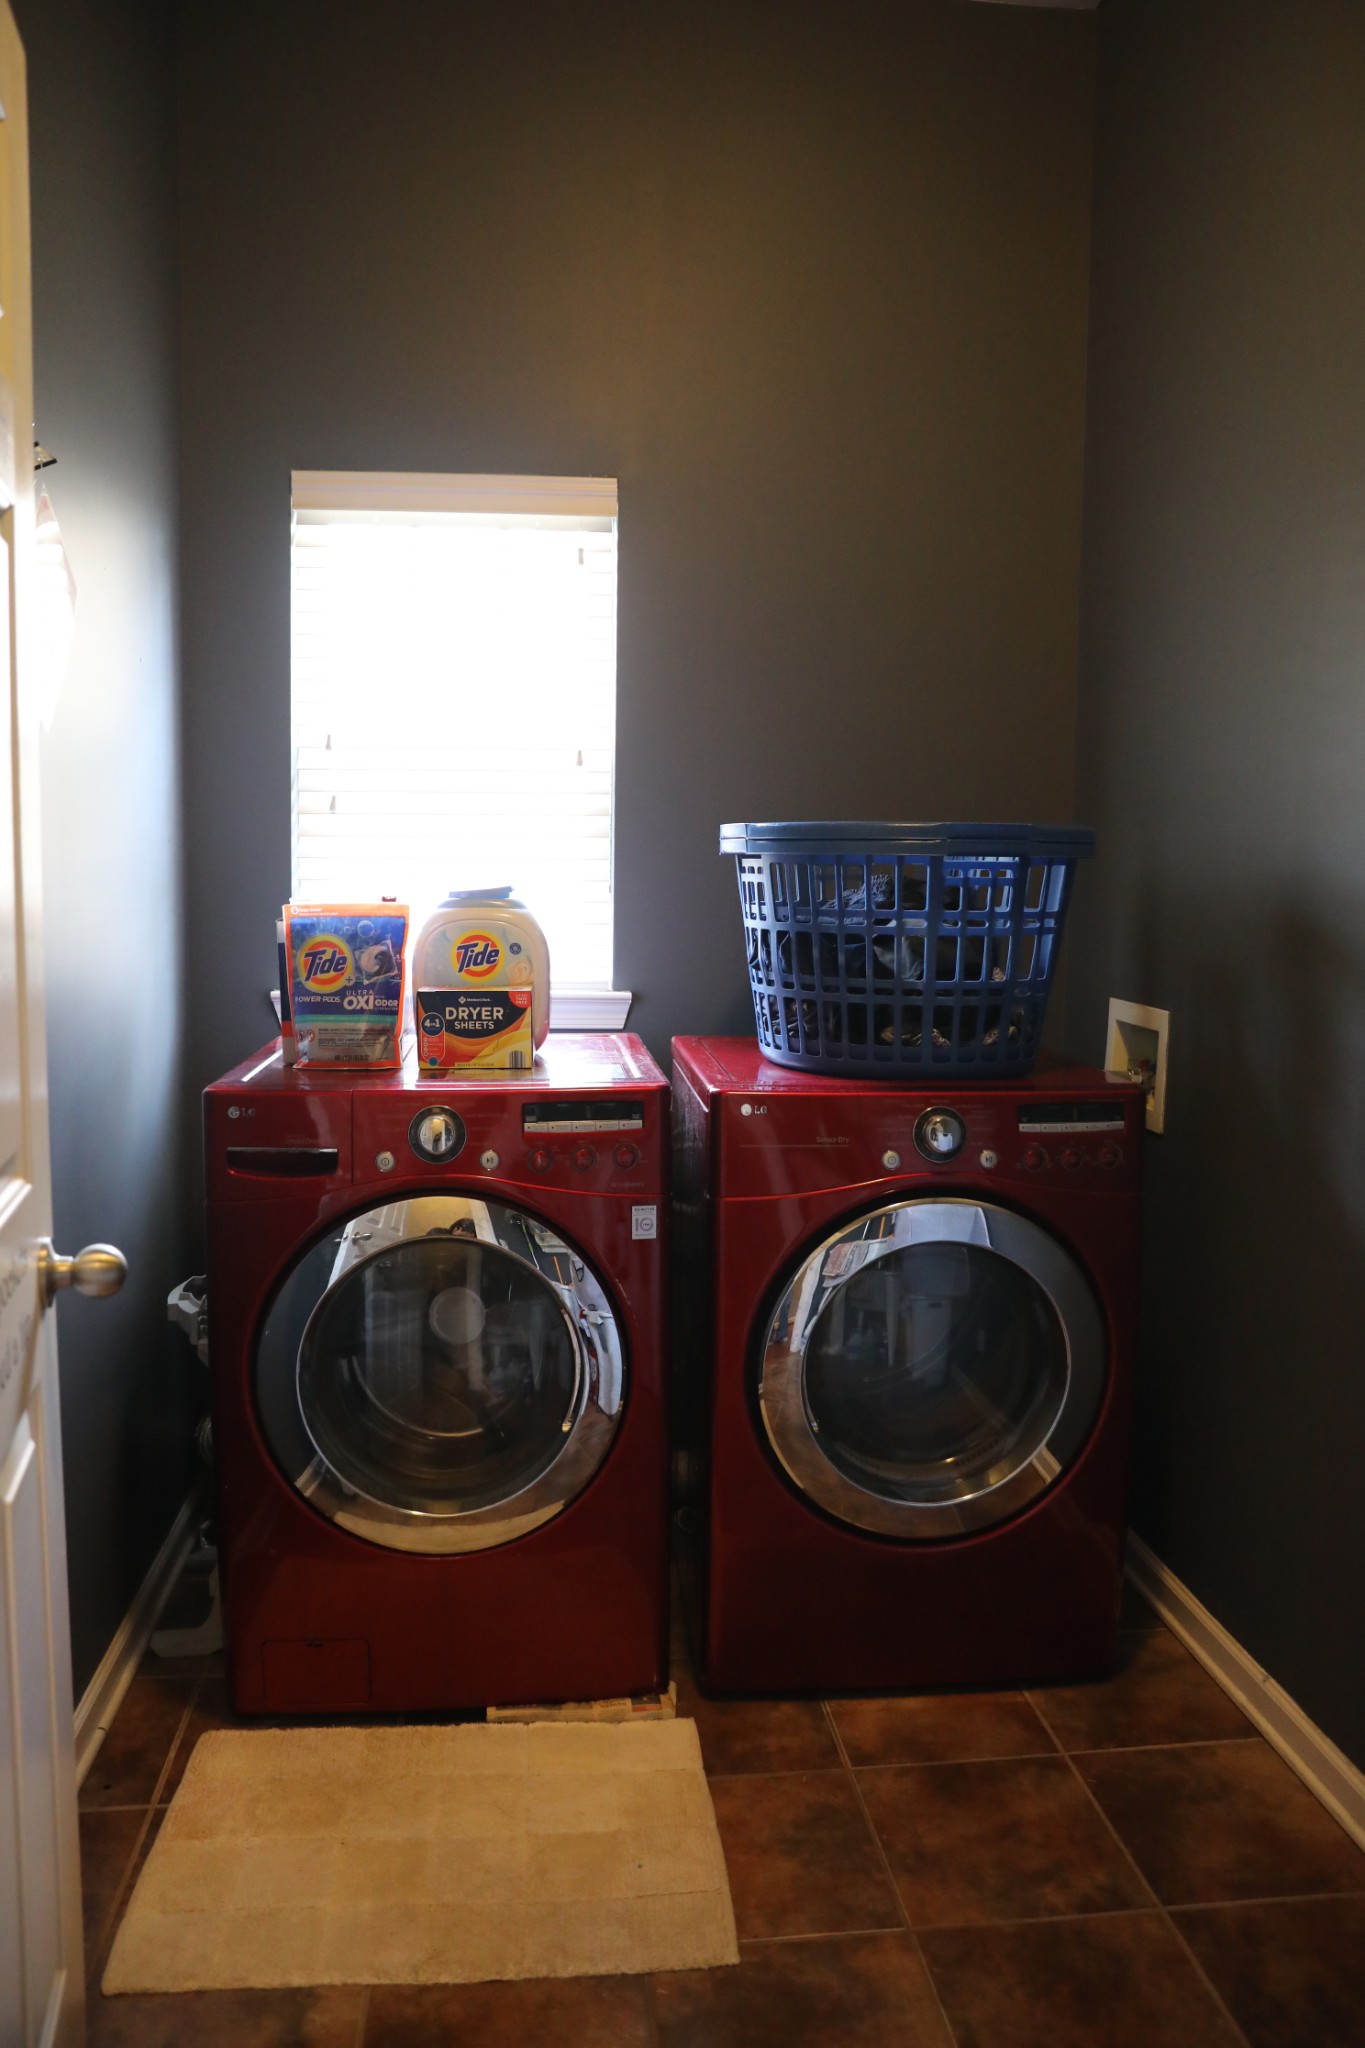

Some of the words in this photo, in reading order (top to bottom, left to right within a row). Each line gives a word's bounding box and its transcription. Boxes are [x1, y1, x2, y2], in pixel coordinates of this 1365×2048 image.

[457, 942, 500, 973] Tide
[304, 949, 347, 982] Tide
[374, 999, 399, 1007] ODOR
[445, 1007, 504, 1020] DRYER
[454, 1021, 495, 1030] SHEETS
